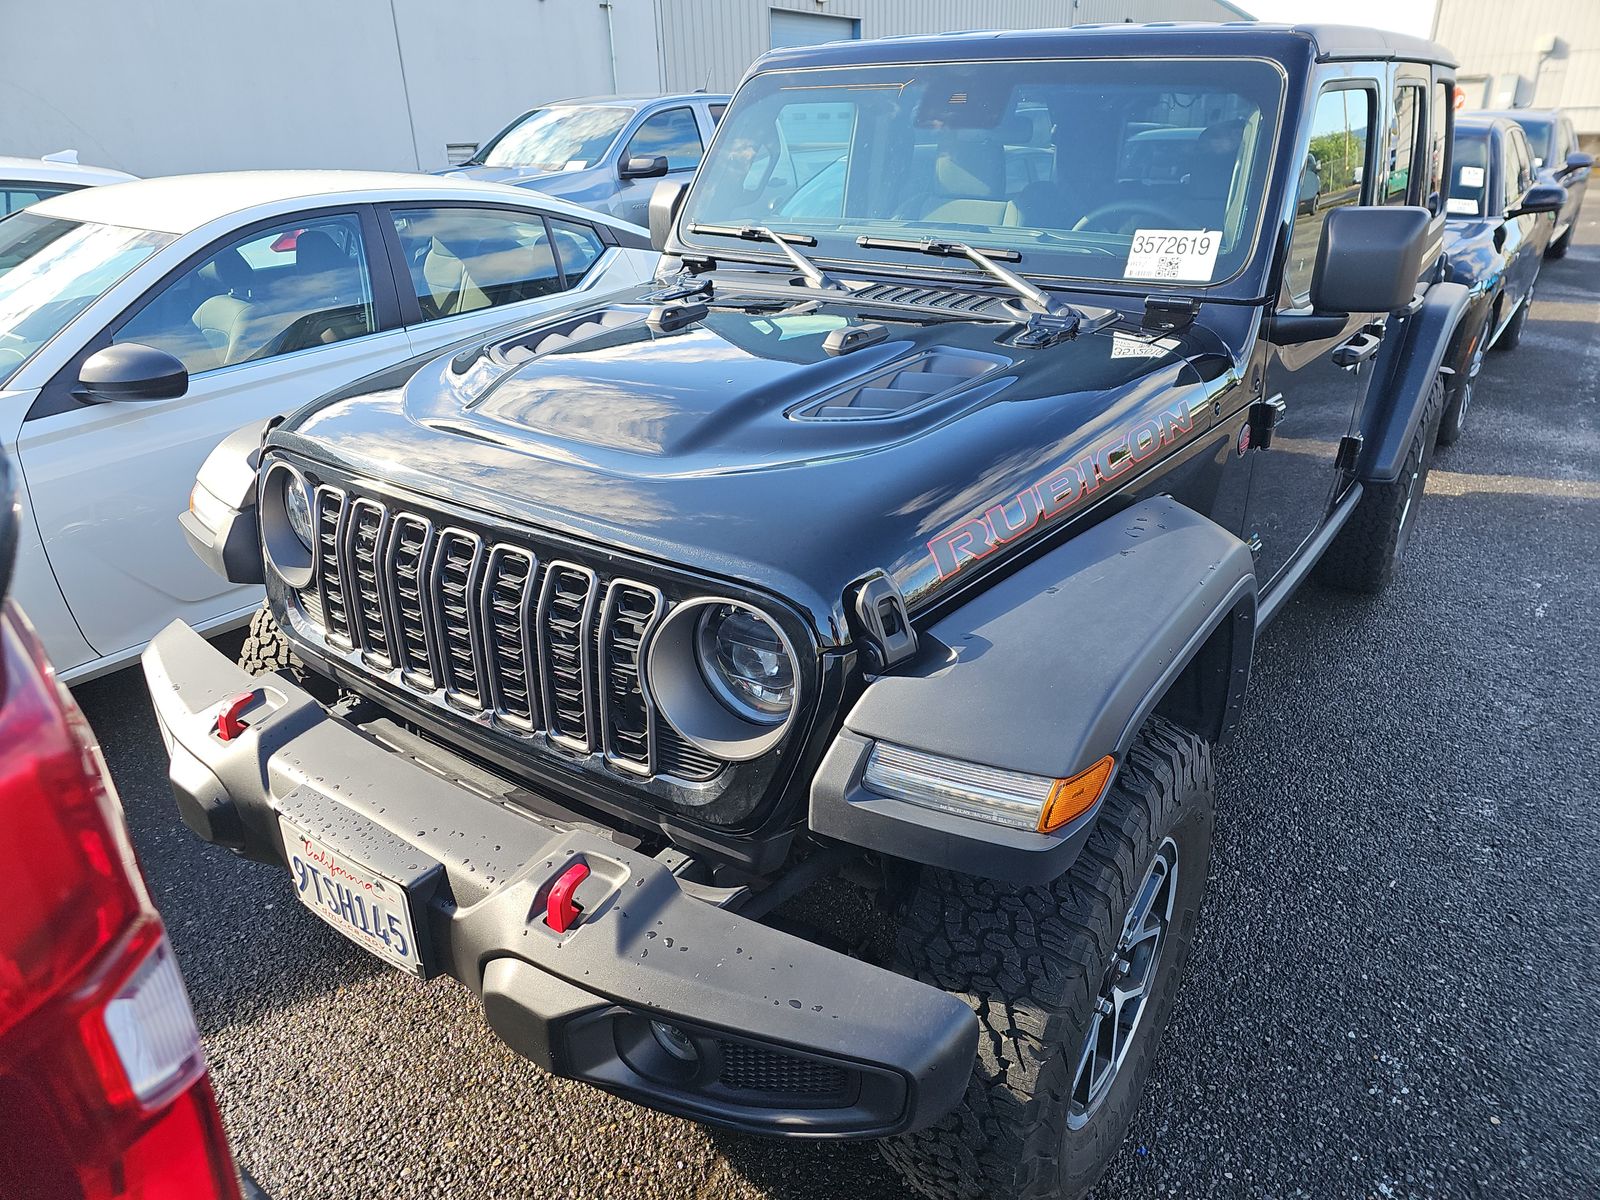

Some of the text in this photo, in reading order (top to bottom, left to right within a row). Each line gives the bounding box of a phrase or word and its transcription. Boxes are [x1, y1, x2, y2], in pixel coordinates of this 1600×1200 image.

[1133, 235, 1211, 256] 3572619
[926, 399, 1194, 581] RUBICON
[293, 856, 409, 957] 9TSH145
[304, 840, 384, 900] California
